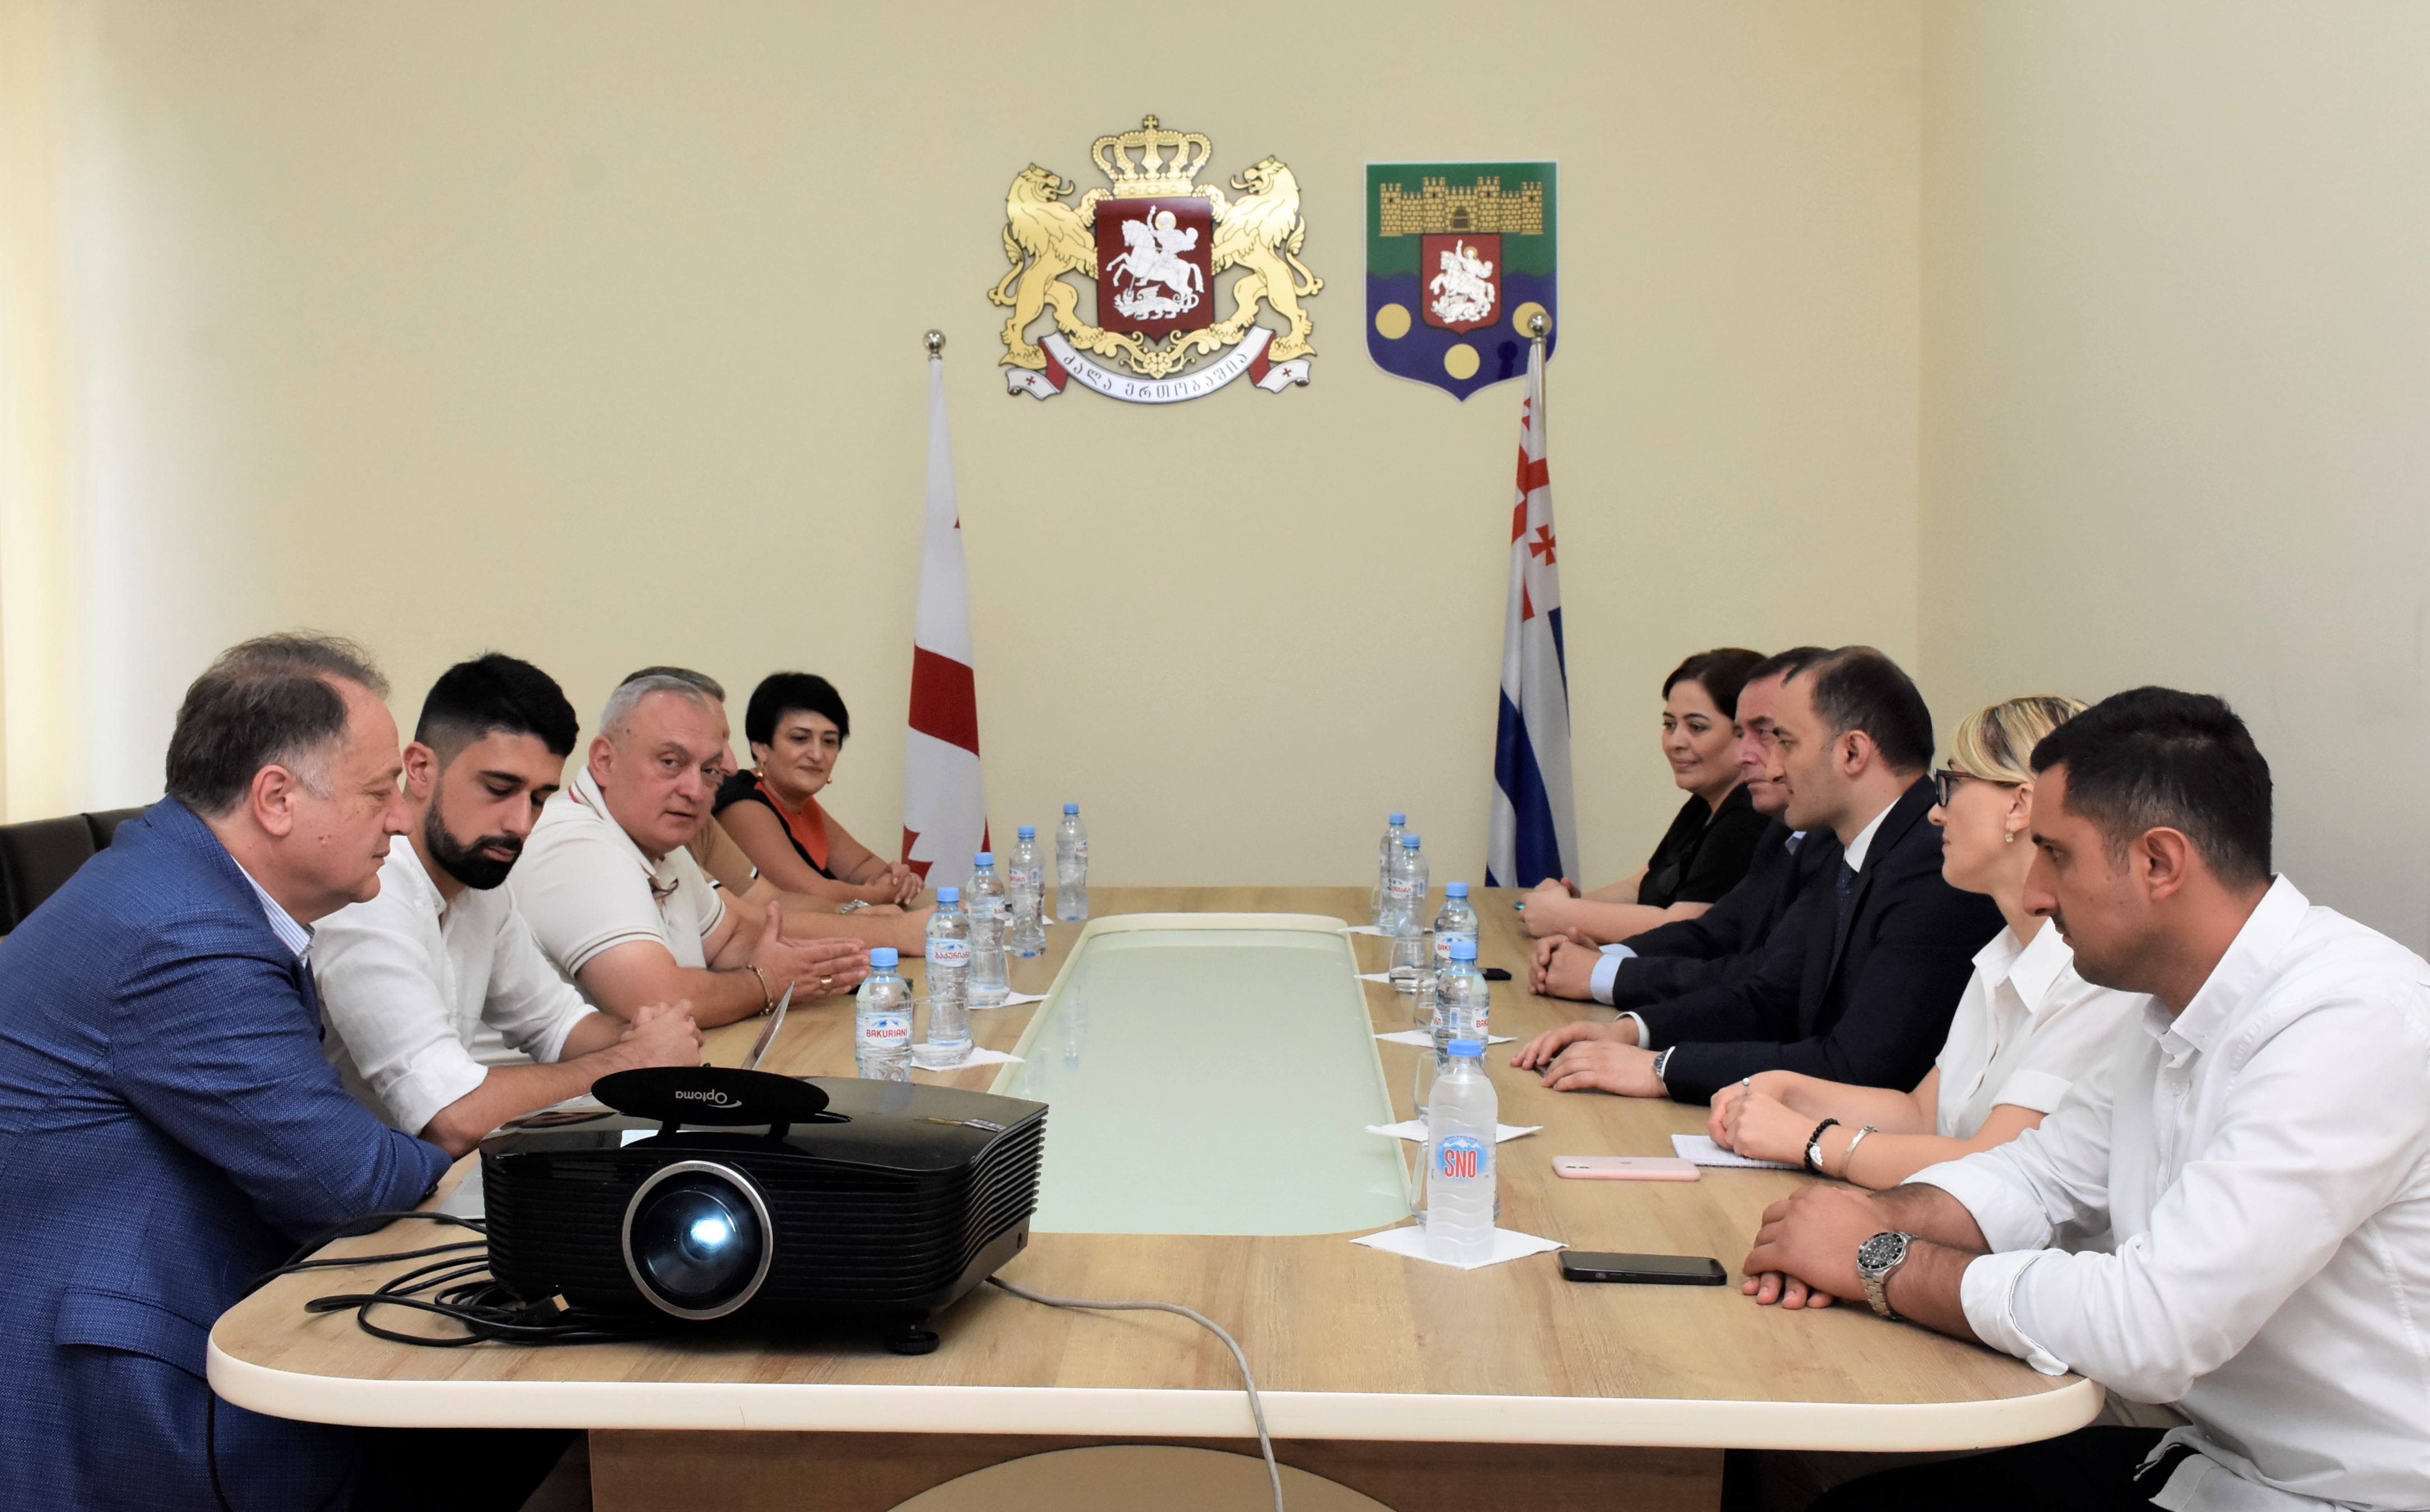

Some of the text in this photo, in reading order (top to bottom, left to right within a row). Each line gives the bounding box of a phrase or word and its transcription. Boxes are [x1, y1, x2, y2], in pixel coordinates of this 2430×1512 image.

[1063, 352, 1248, 398] ძალა ერთობაშია
[866, 1028, 908, 1038] BAKURIANI
[675, 1088, 728, 1104] Optoma
[1444, 1149, 1477, 1178] SNO
